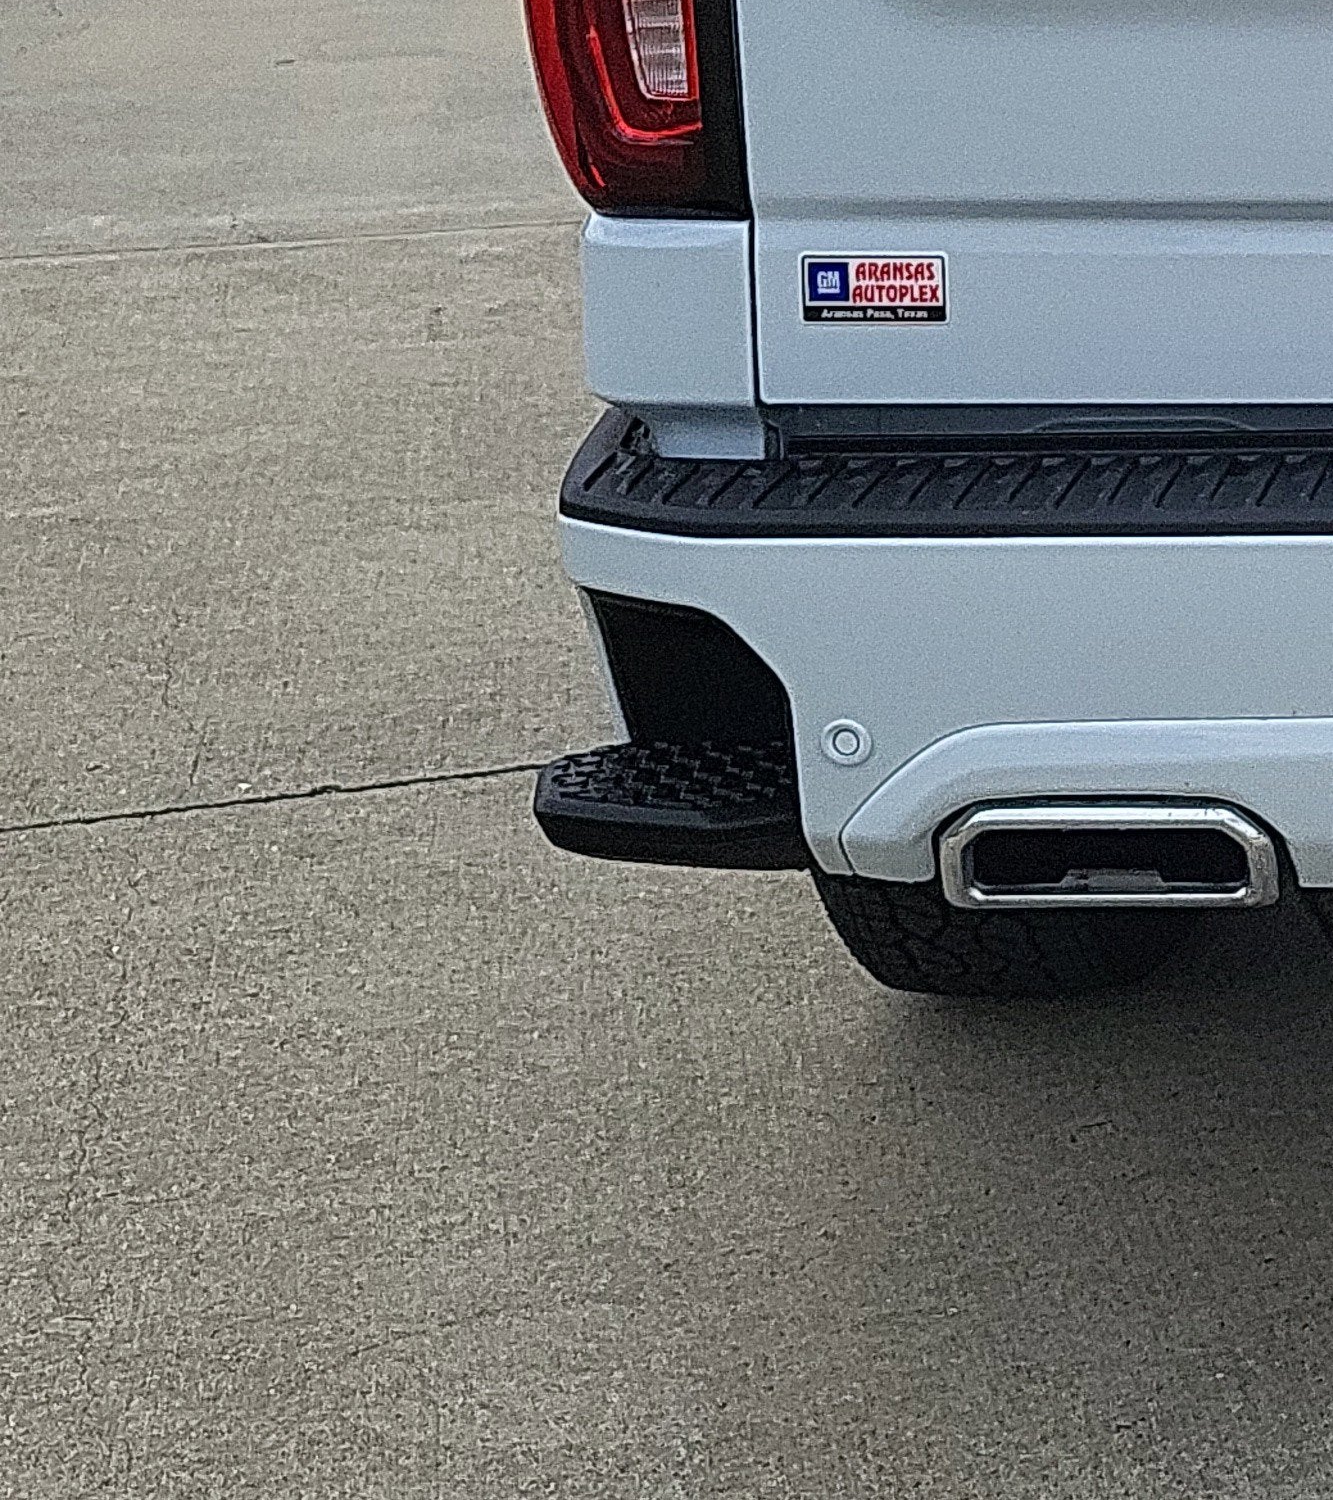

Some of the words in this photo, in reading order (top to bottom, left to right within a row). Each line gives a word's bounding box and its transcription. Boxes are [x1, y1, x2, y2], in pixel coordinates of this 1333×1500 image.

[816, 271, 840, 293] GM
[855, 262, 936, 282] ARANSAS
[852, 284, 940, 304] AUTOPLEX
